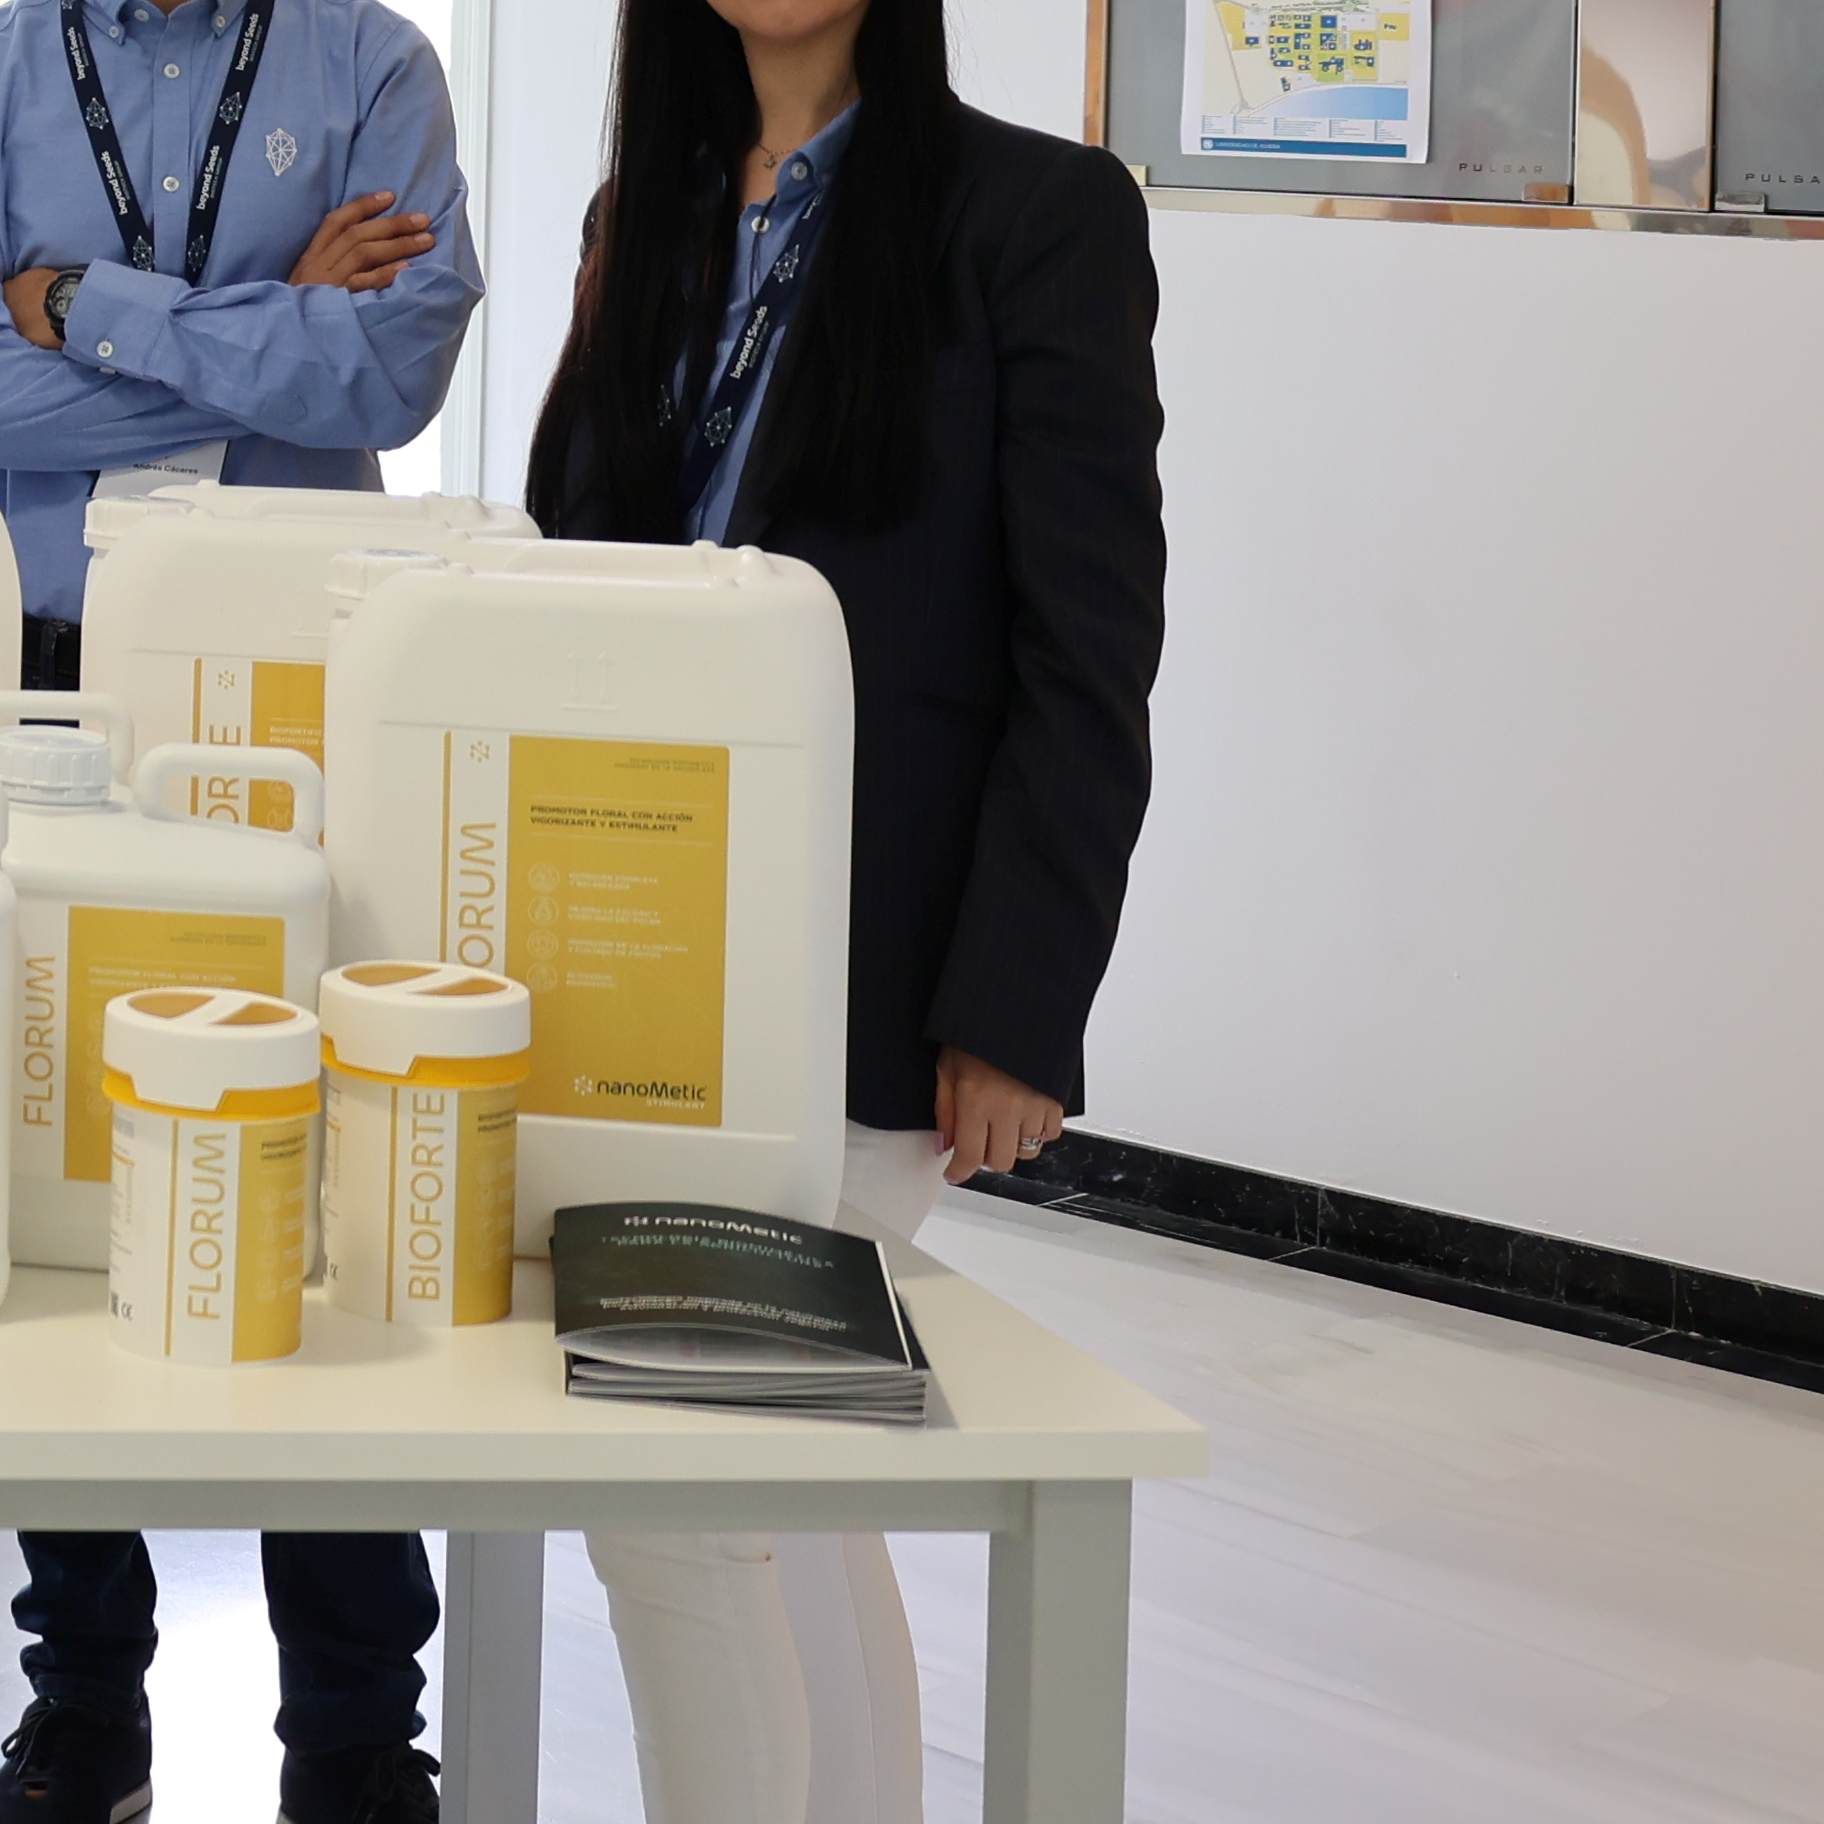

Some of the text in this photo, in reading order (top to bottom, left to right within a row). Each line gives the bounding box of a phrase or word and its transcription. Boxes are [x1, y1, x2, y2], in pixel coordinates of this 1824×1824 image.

[236, 13, 259, 71] beyond Seeds
[72, 49, 86, 80] beyond
[102, 151, 116, 178] Seeds
[196, 174, 213, 210] beyond
[206, 145, 220, 174] Seeds
[1745, 173, 1821, 184] PULSA
[109, 179, 128, 215] beyond
[730, 337, 754, 379] beyond
[747, 306, 768, 337] Seeds
[530, 805, 694, 823] PROMOTOR FLORAL CON ACCIÓN
[530, 816, 598, 829] VIGORIZANTE
[600, 819, 606, 828] Y
[457, 822, 498, 968] ORUM
[23, 956, 55, 1126] FLORUM
[596, 1079, 707, 1102] nanoMetic
[408, 1092, 445, 1301] BIOFORTE
[186, 1132, 227, 1320] FLORUM
[654, 1216, 802, 1246] nanoMetic
